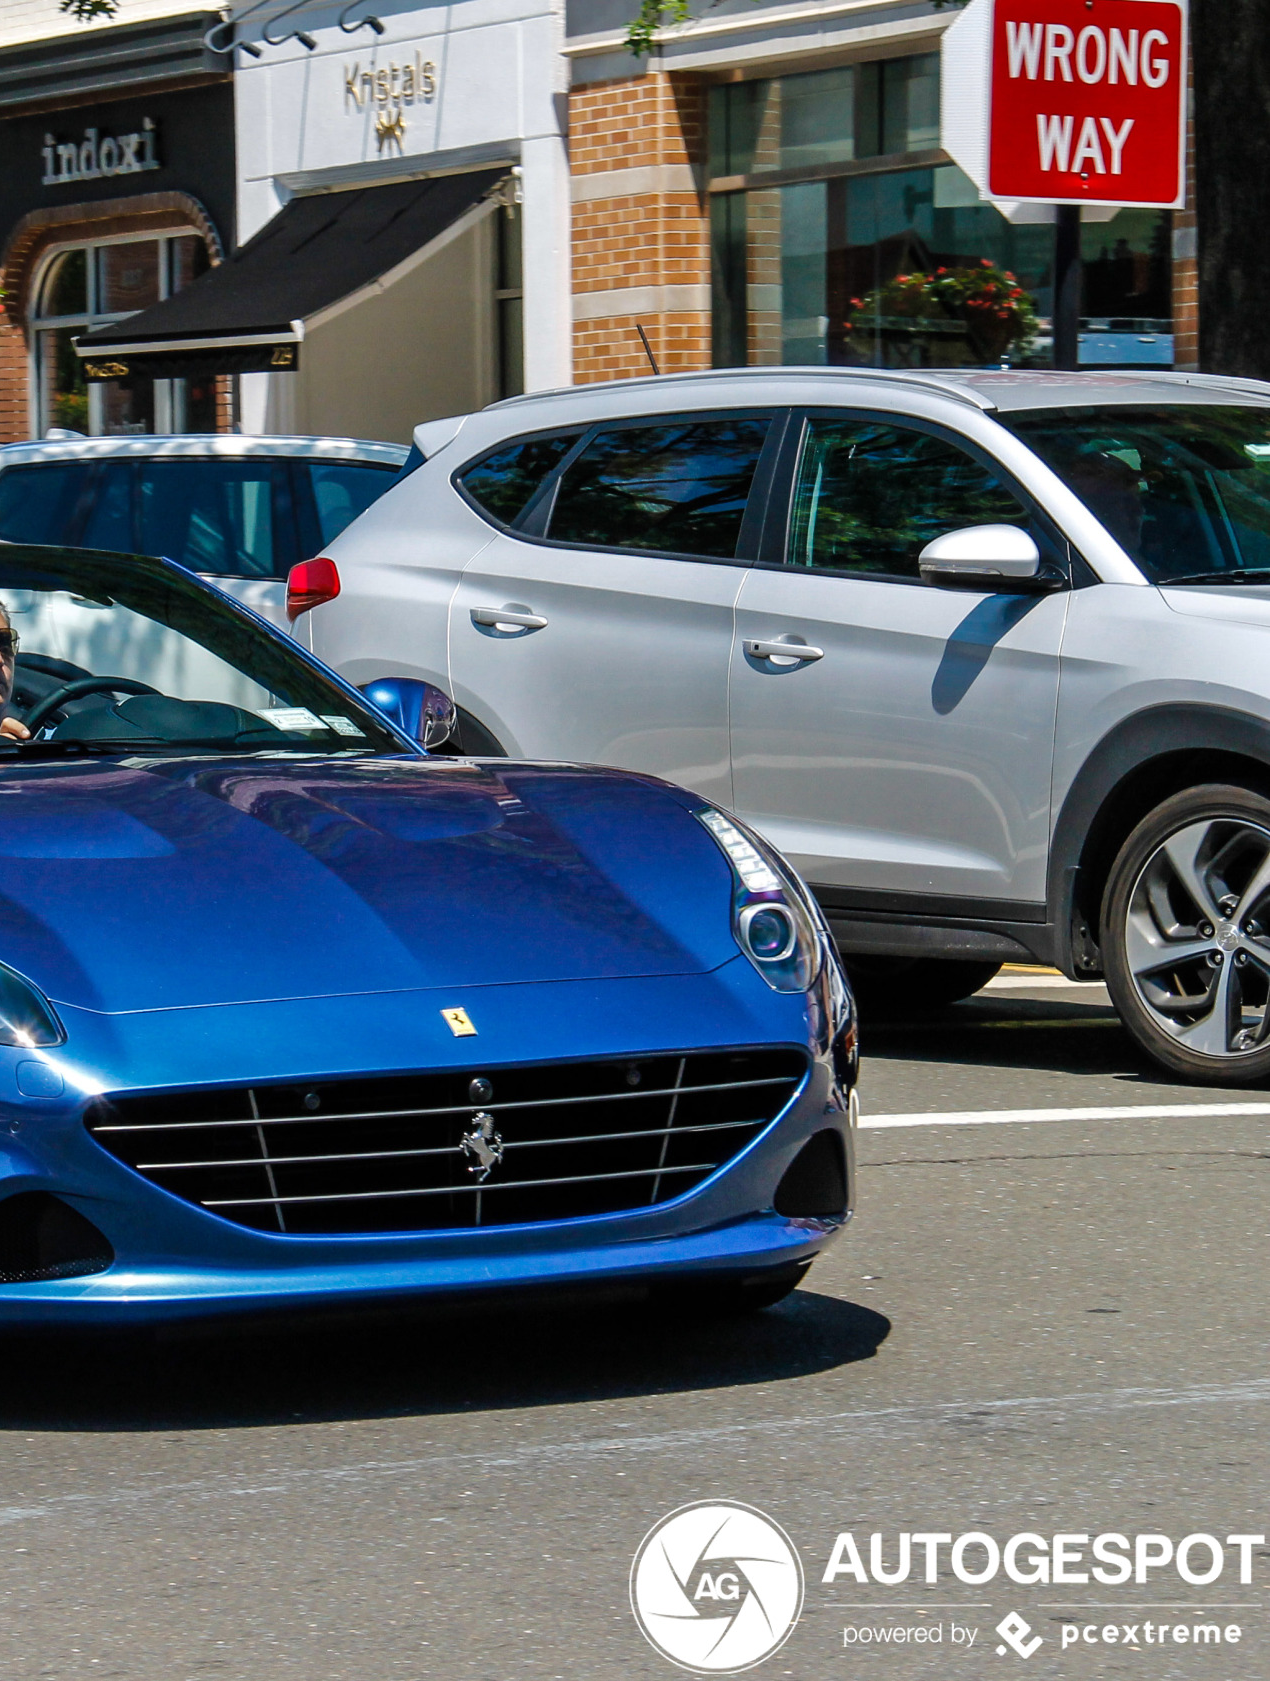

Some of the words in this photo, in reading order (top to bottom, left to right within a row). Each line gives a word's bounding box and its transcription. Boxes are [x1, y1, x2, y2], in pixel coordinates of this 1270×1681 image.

[343, 49, 436, 107] Kristals
[1005, 21, 1170, 89] WRONG
[41, 116, 160, 185] indoxi
[1036, 113, 1135, 175] WAY
